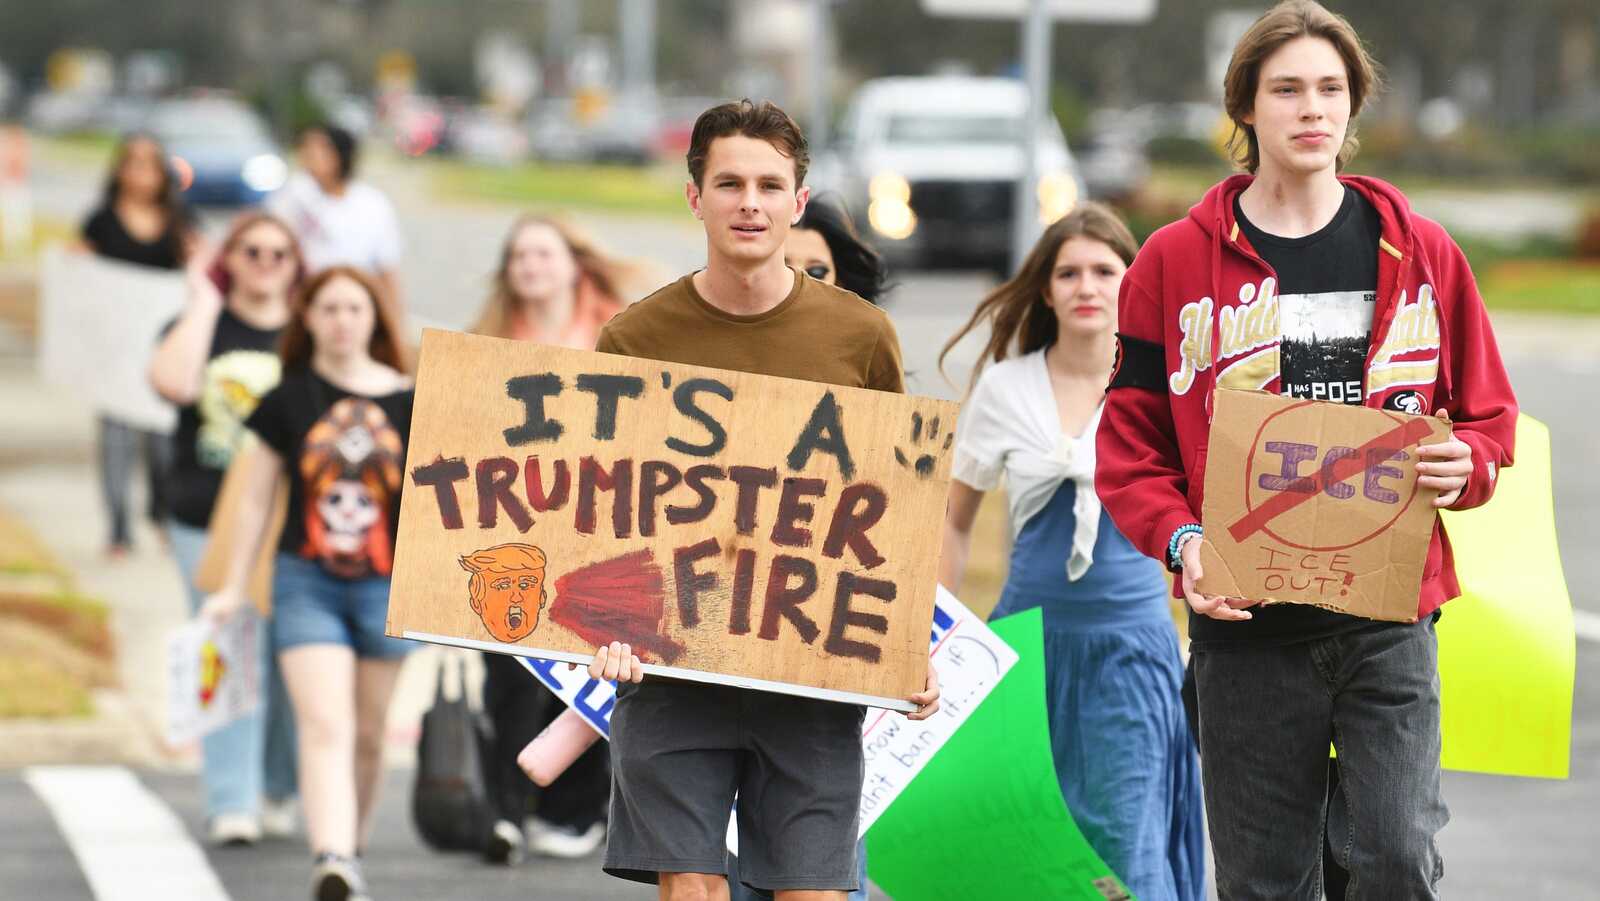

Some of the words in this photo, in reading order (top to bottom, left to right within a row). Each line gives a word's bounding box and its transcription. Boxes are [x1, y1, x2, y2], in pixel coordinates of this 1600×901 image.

[503, 371, 734, 458] IT'S
[786, 389, 856, 481] A
[1258, 441, 1410, 505] ICE
[410, 454, 889, 569] TRUMPSTER
[1255, 545, 1353, 572] ICE
[1264, 571, 1356, 597] OUT!
[673, 537, 898, 663] FIRE
[889, 730, 935, 768] ban
